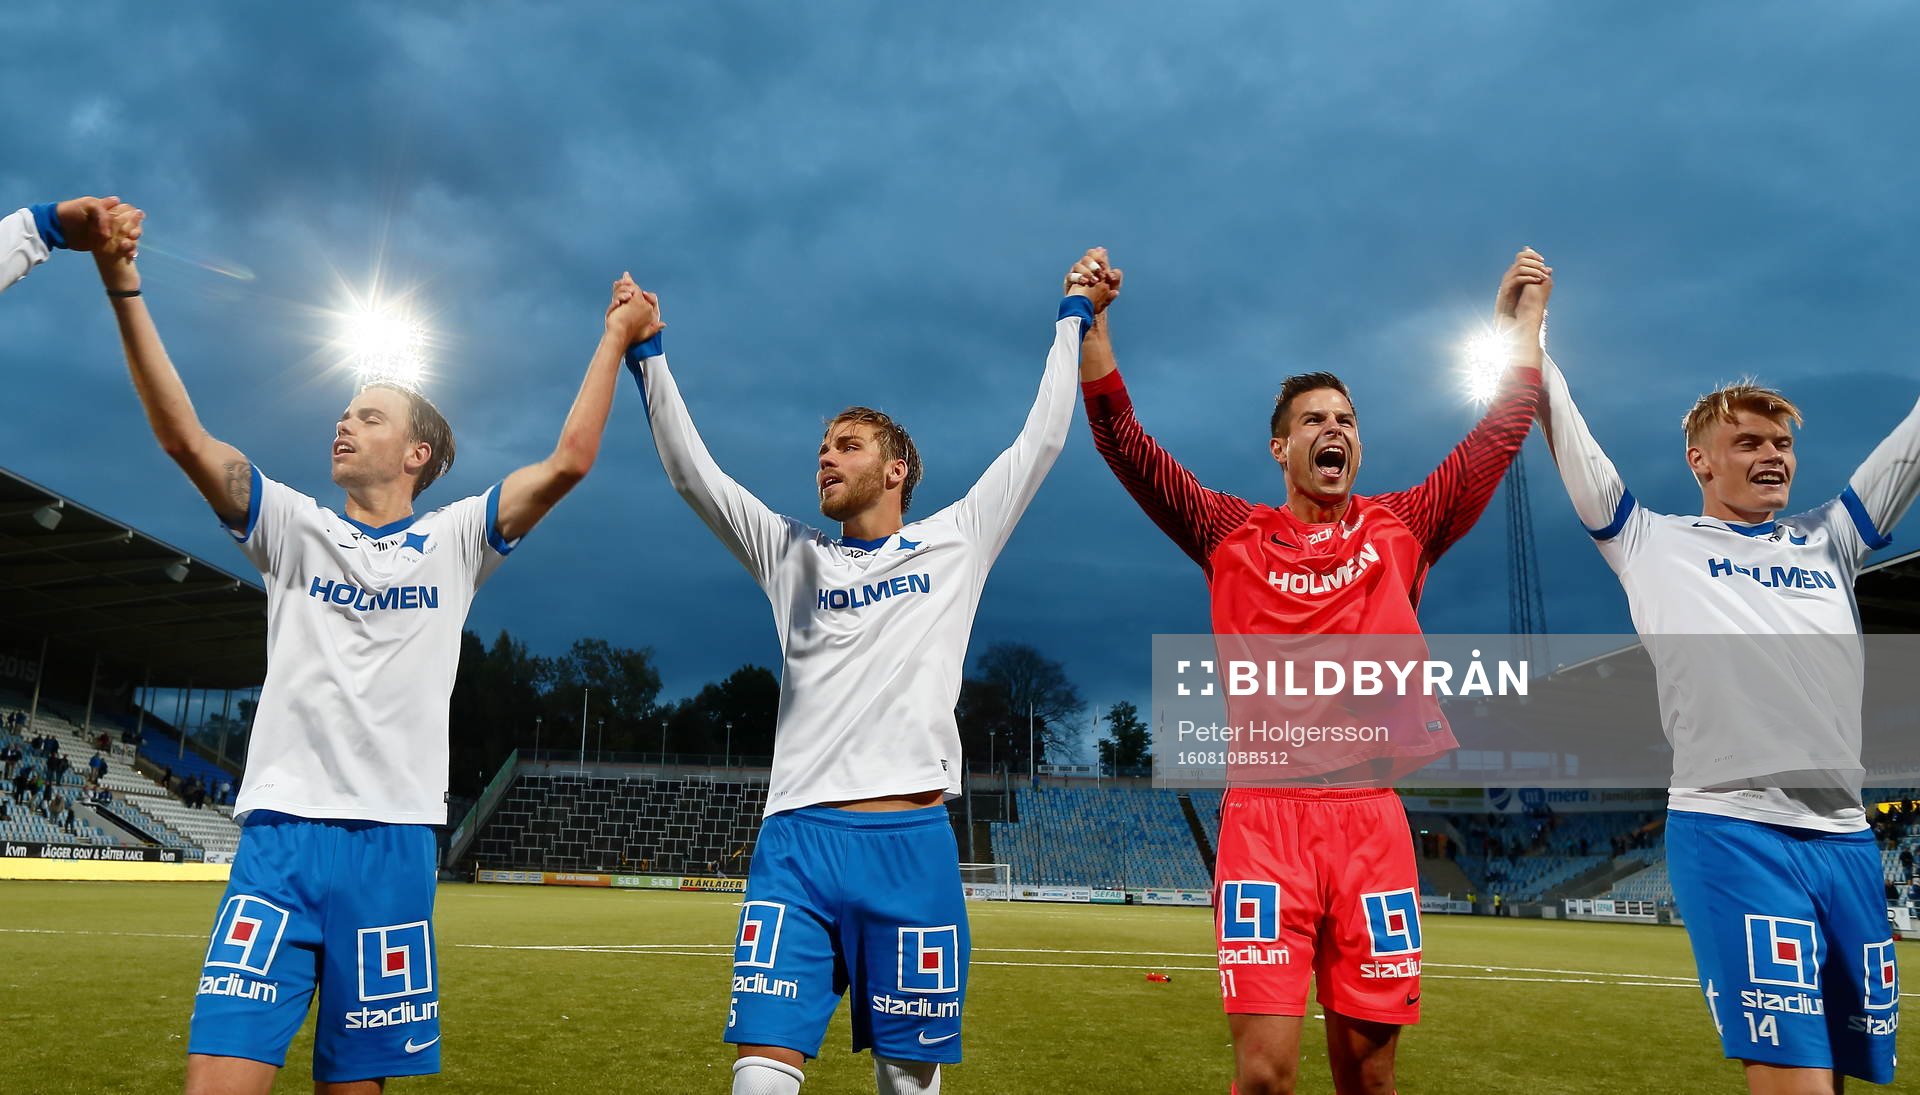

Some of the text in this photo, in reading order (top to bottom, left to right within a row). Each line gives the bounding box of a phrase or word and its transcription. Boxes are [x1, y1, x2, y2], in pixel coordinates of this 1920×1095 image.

[1267, 543, 1380, 594] HOLMEN
[309, 576, 439, 611] HOLMEN
[817, 573, 931, 610] HOLMEN
[5, 842, 27, 857] kvm
[41, 844, 71, 859] LÄGGER
[73, 847, 93, 860] GOLV
[101, 847, 124, 861] SÄTTER
[159, 849, 176, 862] kvm
[618, 877, 639, 885] SEB
[651, 878, 672, 886] SEB
[1094, 890, 1122, 899] SEFAB
[1360, 957, 1421, 978] stadiu
[872, 994, 959, 1018] stadium
[1741, 988, 1825, 1015] stadiu
[1743, 1011, 1780, 1046] 14
